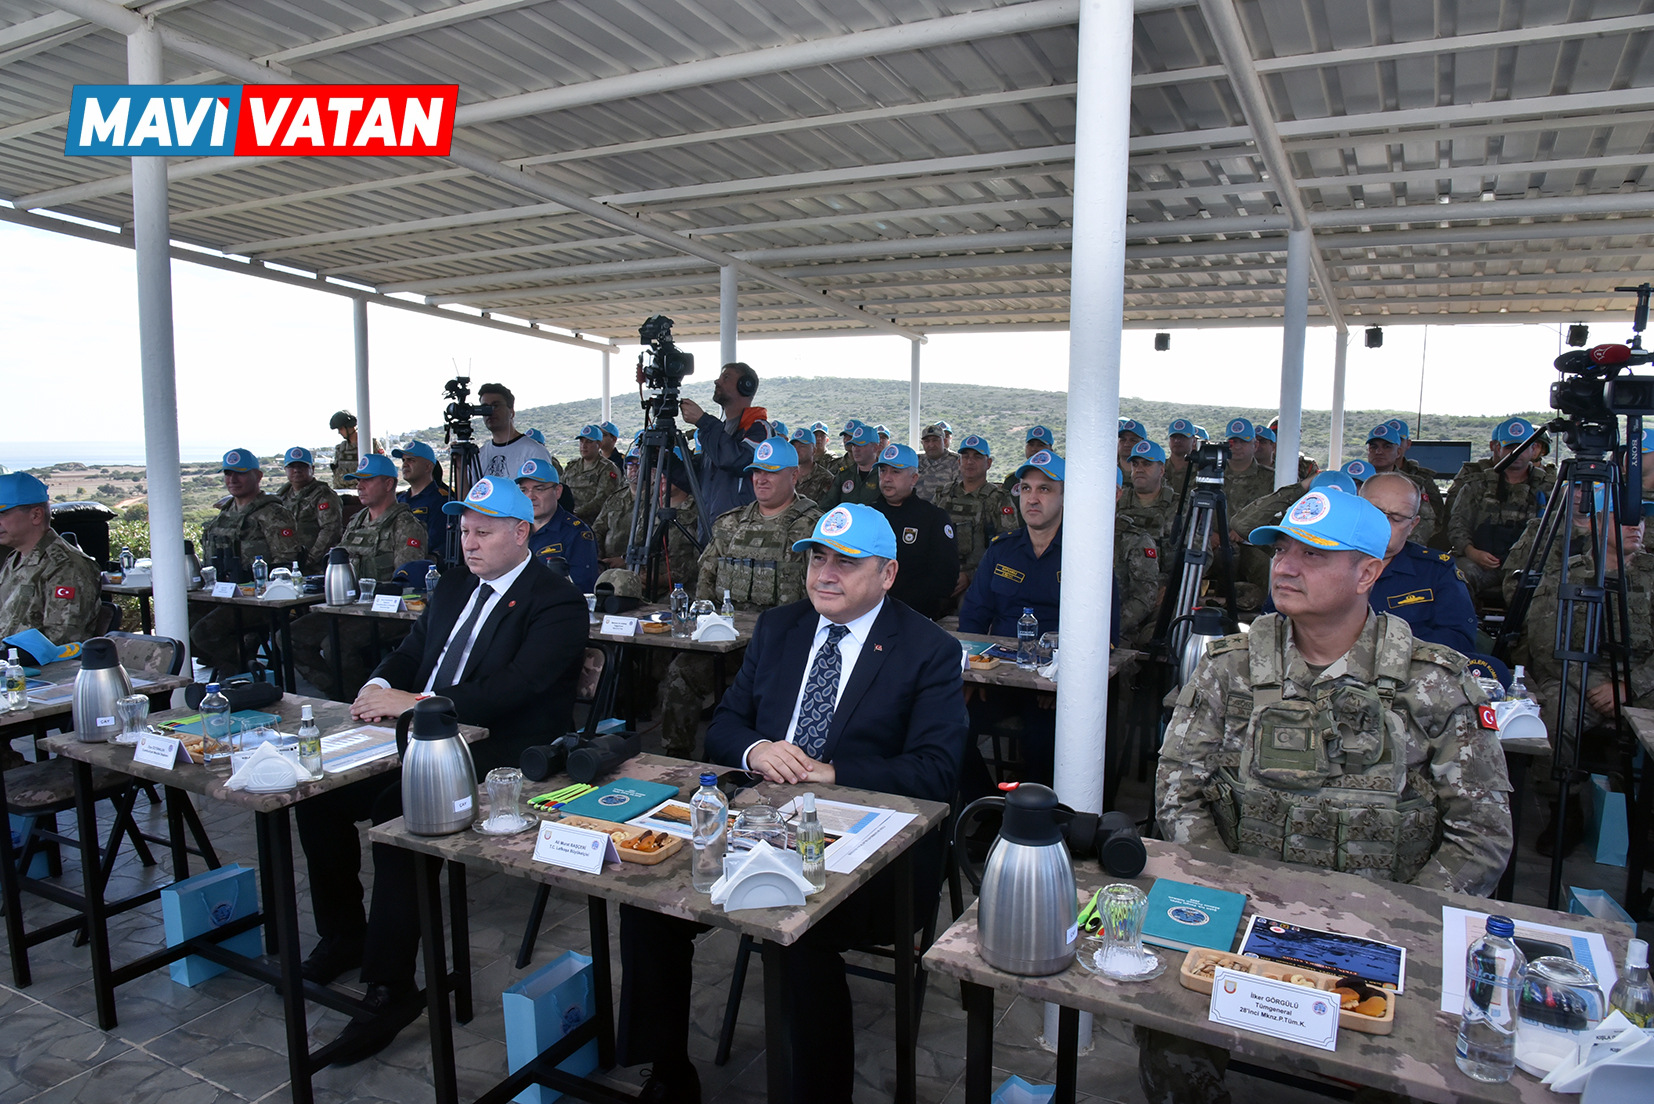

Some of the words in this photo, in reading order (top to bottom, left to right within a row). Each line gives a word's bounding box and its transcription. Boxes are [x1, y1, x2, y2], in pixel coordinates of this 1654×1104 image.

[1250, 991, 1264, 1001] İlker
[1265, 996, 1299, 1009] GÖRGÜLÜ
[1239, 1006, 1260, 1017] 28'inci
[1255, 1002, 1292, 1016] Tümgeneral
